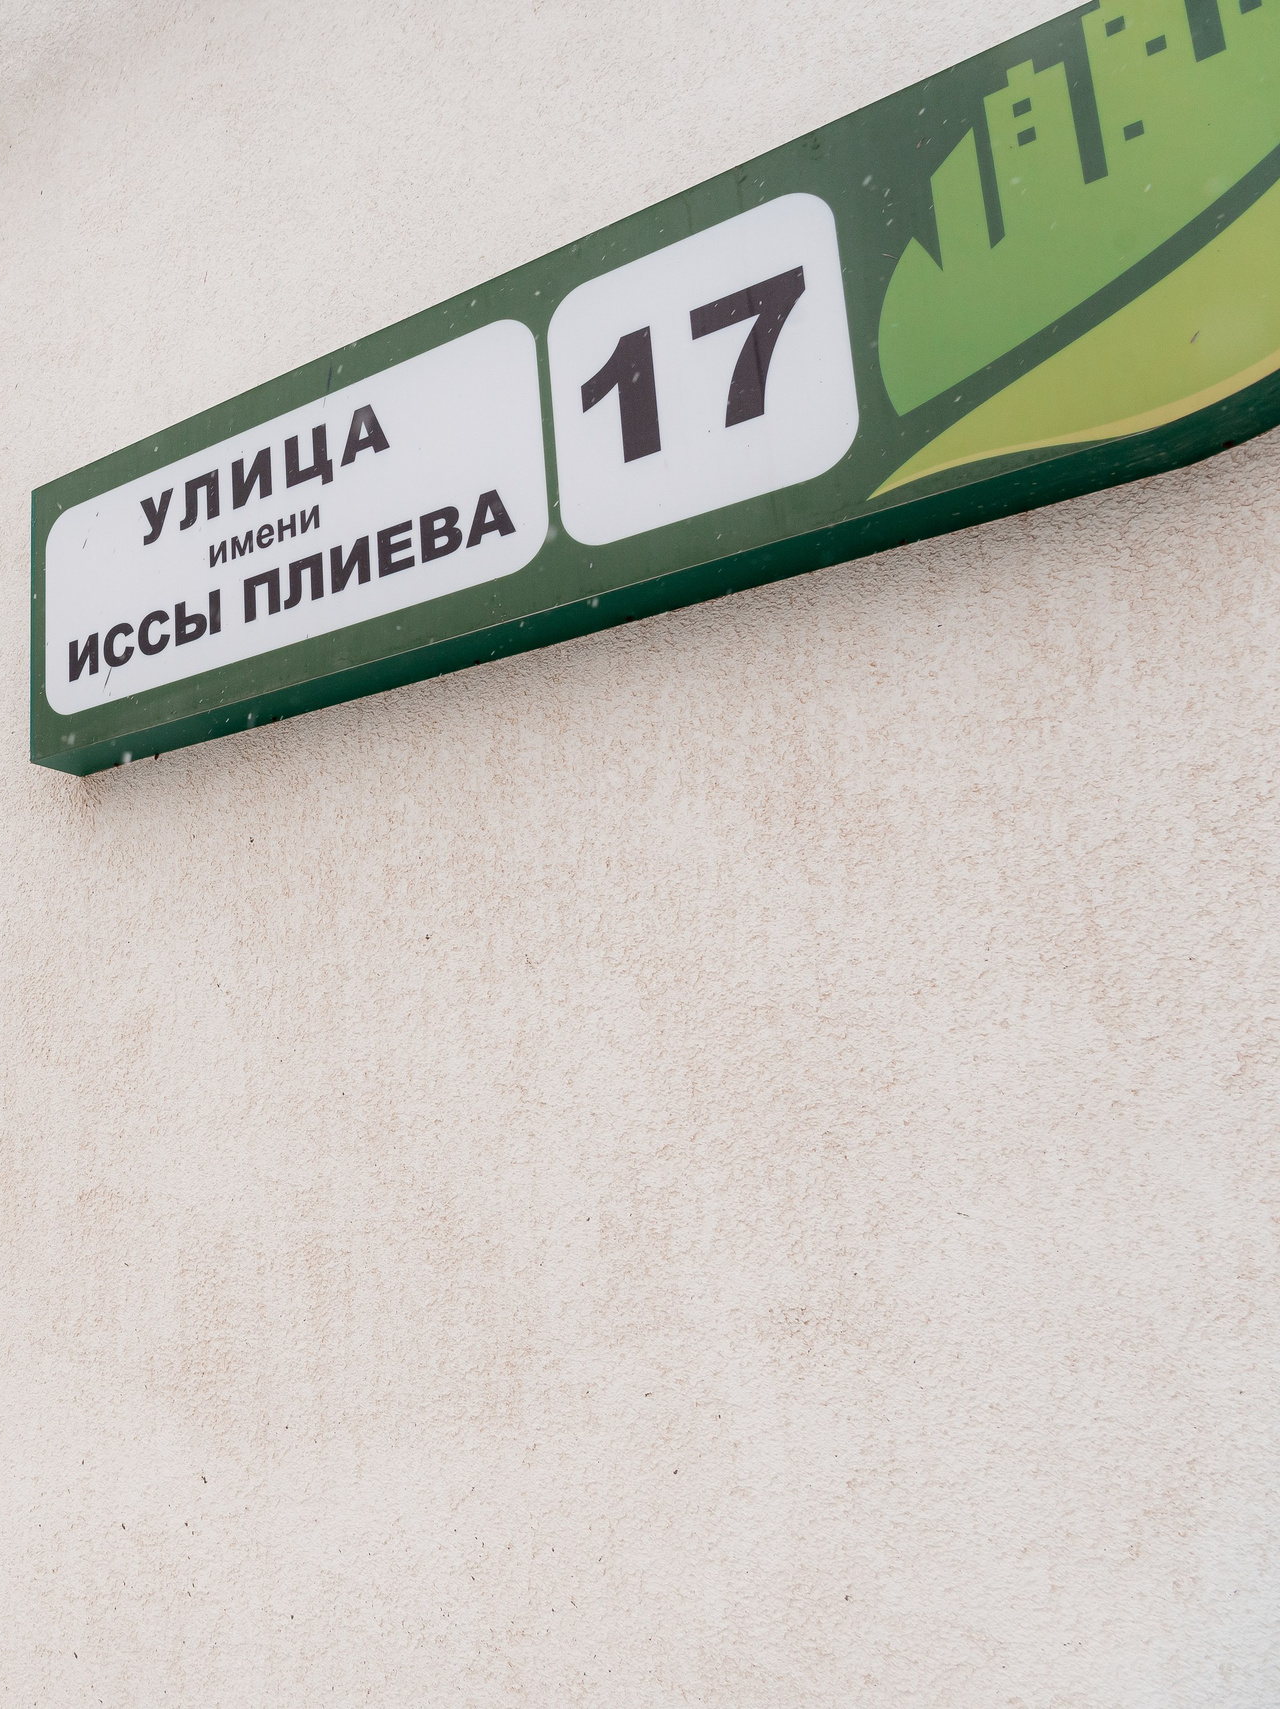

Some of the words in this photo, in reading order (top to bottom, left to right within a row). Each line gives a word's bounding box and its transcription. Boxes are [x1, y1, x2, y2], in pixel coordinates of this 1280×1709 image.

[580, 265, 806, 464] 17
[139, 403, 391, 546] УЛИЦА
[208, 504, 321, 569] имени
[68, 588, 223, 683] ИССЫ
[243, 489, 517, 624] ПЛИЕВА
